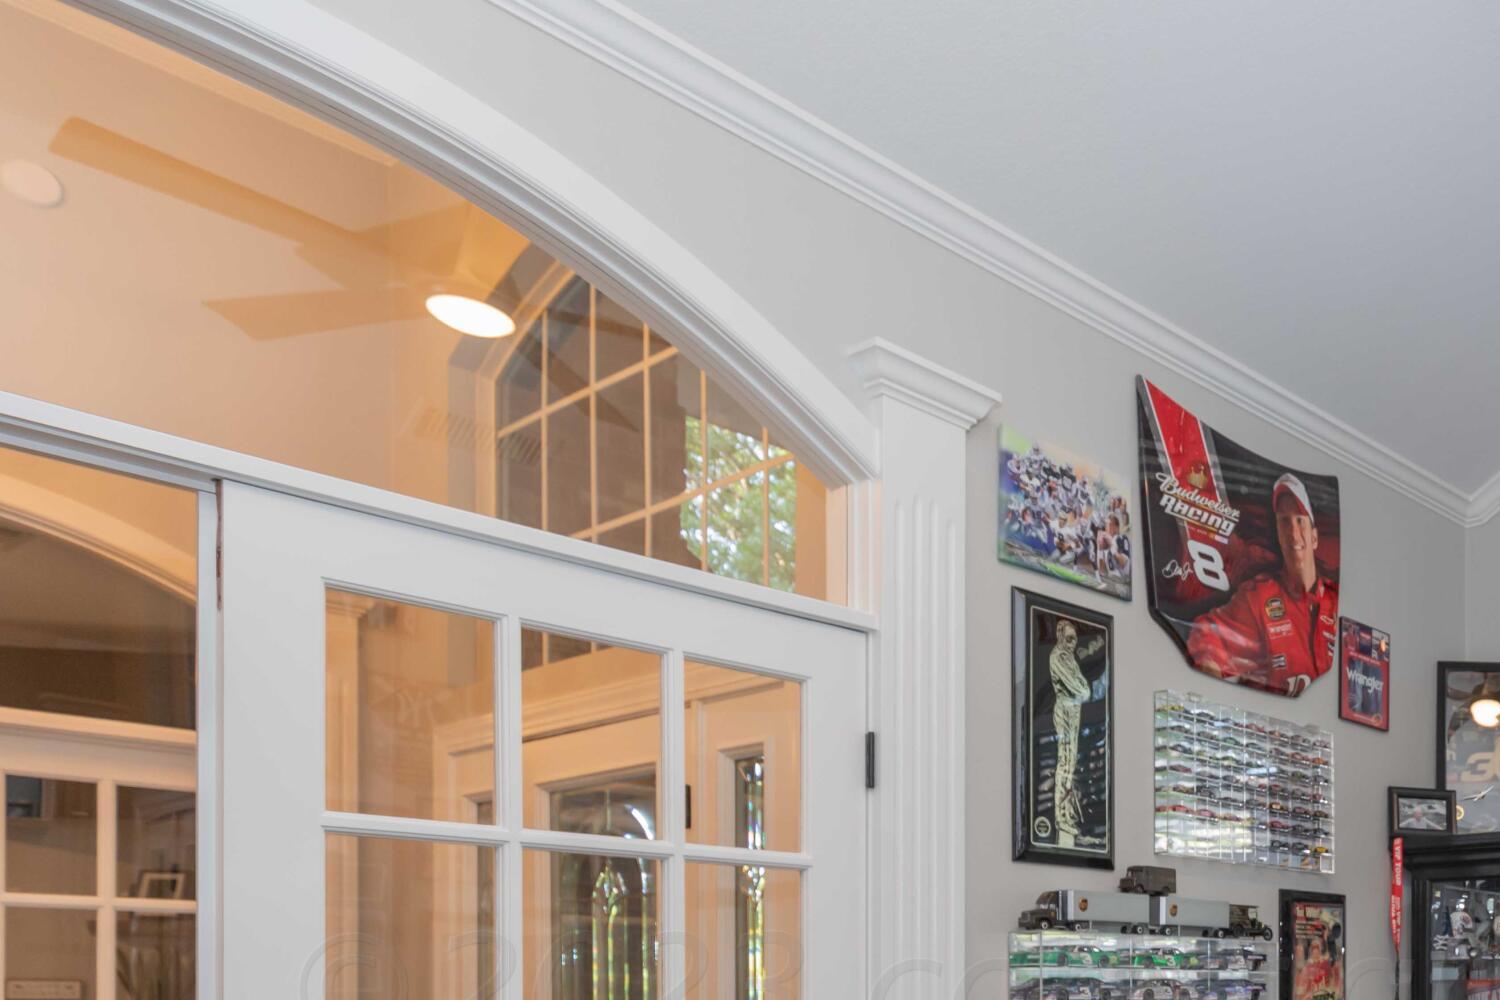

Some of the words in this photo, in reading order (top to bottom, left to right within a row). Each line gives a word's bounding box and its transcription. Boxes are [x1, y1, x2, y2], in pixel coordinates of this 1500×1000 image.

[1156, 472, 1241, 518] Budweiser
[1187, 539, 1231, 592] 8
[1346, 666, 1384, 694] Wrangler
